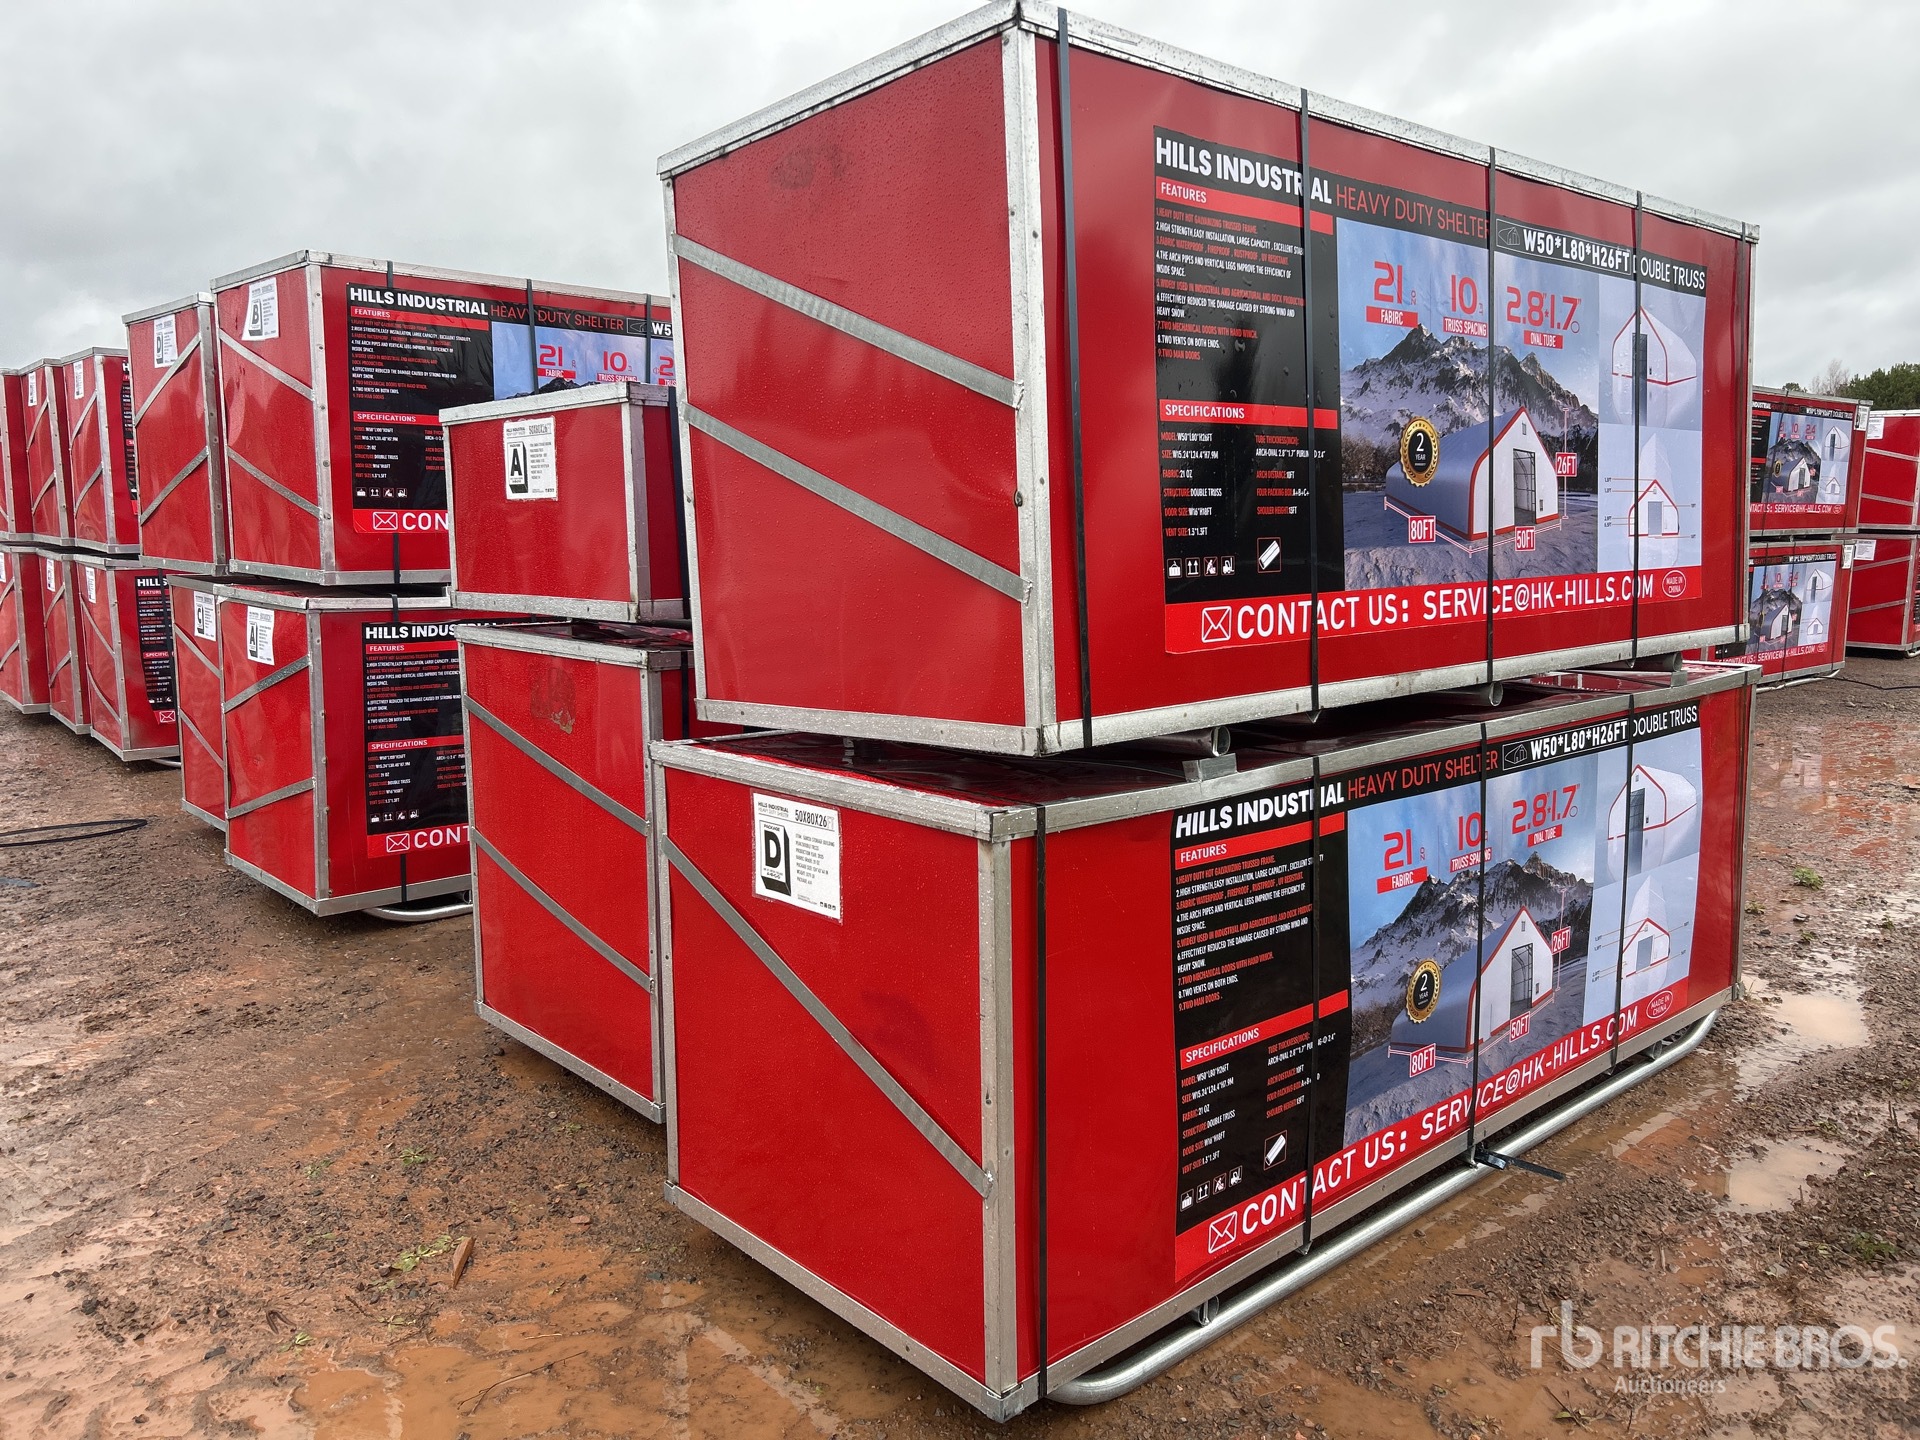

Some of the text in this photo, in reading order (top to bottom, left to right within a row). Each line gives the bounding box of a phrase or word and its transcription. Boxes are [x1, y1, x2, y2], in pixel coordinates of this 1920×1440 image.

[1161, 182, 1207, 203] FEATURES
[1156, 136, 1211, 176] HILLS
[1216, 153, 1332, 204] INDUSTRAL
[1336, 184, 1390, 217] HEAVY
[1395, 198, 1433, 227] DUTY
[1673, 266, 1705, 290] TRUSS
[1374, 260, 1403, 305] 21
[1451, 274, 1478, 315] 10
[252, 304, 259, 324] B
[350, 287, 394, 305] HILLS
[398, 293, 488, 316] INDUSTRIAL
[538, 310, 571, 326] DUTY
[575, 314, 624, 330] SHELTER
[354, 309, 390, 318] FEATURES
[1380, 308, 1404, 326] FABIRC
[1445, 318, 1487, 336] TRUSS SPACING
[1543, 334, 1556, 347] TUBE
[540, 344, 562, 367] 21
[604, 351, 627, 372] 10
[357, 414, 416, 422] SPECIFICATIONS
[1165, 405, 1245, 419] SPECIFICATIONS
[1416, 433, 1424, 451] 2
[510, 448, 522, 476] A
[1556, 455, 1576, 475] 26FT
[1410, 516, 1434, 541] 80FT
[1516, 528, 1534, 550] 50FT
[1237, 596, 1360, 638] CONTACT
[250, 626, 255, 645] A
[366, 626, 408, 639] HILLS
[1758, 645, 1815, 661] SERVICE@K-HILLS.COM
[371, 740, 428, 750] SPECIFICATIONS
[1175, 805, 1232, 838] HILLS
[1348, 770, 1397, 800] HEAVY
[1402, 762, 1442, 788] DUTY
[1670, 705, 1697, 728] TRUSS
[414, 826, 470, 849] CONT
[1458, 812, 1482, 850] 10
[1545, 826, 1556, 841] TUBE
[764, 830, 781, 868] D
[1180, 844, 1227, 863] FEATURES
[1384, 829, 1412, 871] 21
[1452, 849, 1492, 871] TRUSS SPANG
[1391, 871, 1414, 889] FABIRC
[1190, 909, 1201, 919] ARCH
[1202, 906, 1214, 916] PIPES
[1215, 903, 1223, 913] AND
[1224, 898, 1243, 910] VERTICAL
[1244, 896, 1254, 905] LEGS
[1255, 891, 1272, 903] IMPROVE
[1281, 884, 1300, 896] EFFICIENCY
[1301, 883, 1306, 891] OF
[1177, 924, 1191, 936] INSIDE
[1552, 929, 1570, 952] 26FT
[1194, 984, 1206, 994] VENTS
[1207, 982, 1214, 991] ON
[1215, 978, 1226, 989] BOTH
[1420, 974, 1428, 991] 2
[1653, 1004, 1666, 1016] CHINA
[1510, 1013, 1529, 1040] 50FT
[1186, 1028, 1259, 1062] SPECIFICATIONS
[1411, 1045, 1434, 1074] 80FT
[1242, 1149, 1356, 1234] CONTACT
